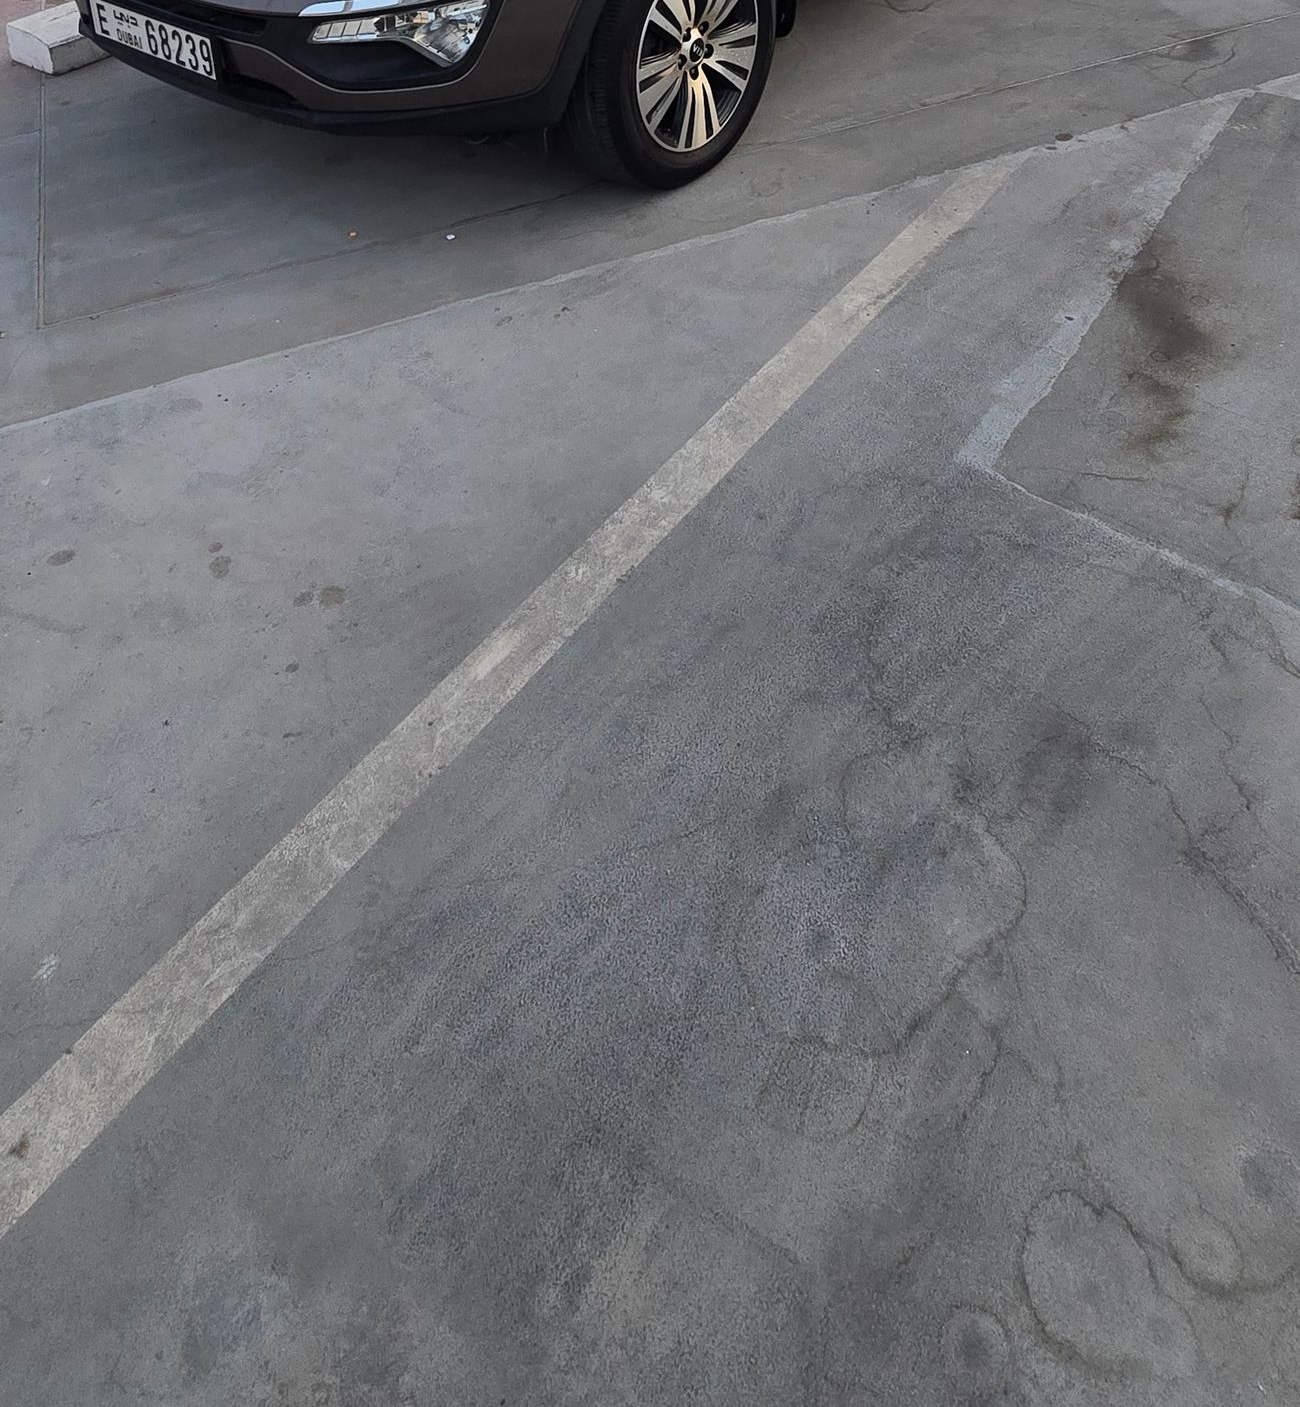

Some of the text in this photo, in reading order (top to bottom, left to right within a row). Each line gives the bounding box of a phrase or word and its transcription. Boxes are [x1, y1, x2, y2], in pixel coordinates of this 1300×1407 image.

[96, 3, 213, 76] E 68239
[116, 28, 143, 50] DUBAI
